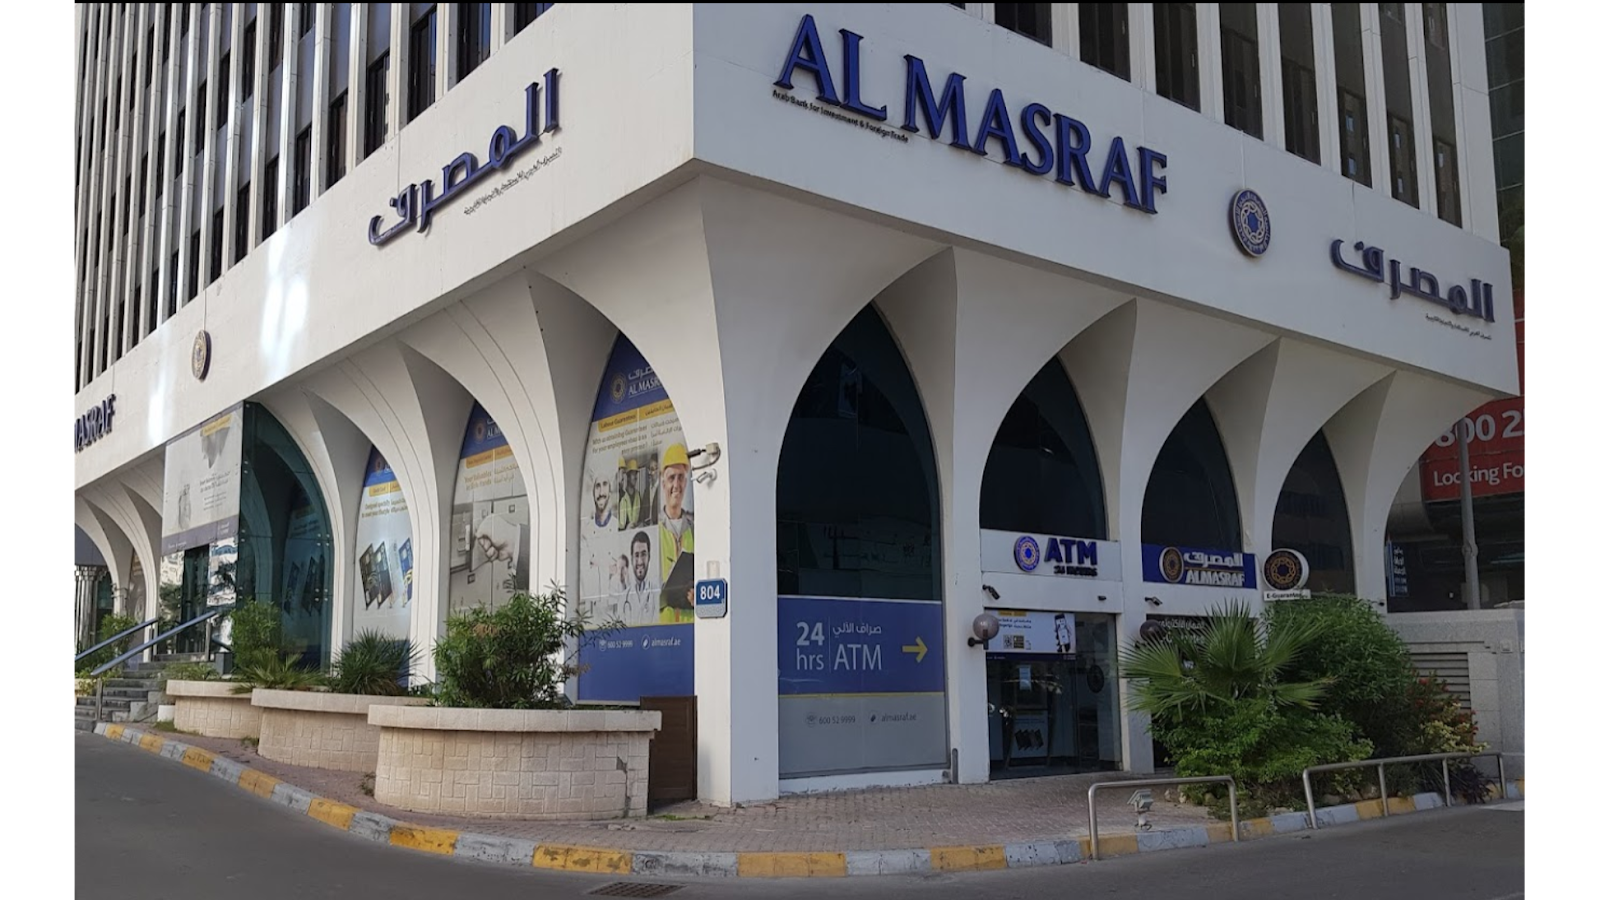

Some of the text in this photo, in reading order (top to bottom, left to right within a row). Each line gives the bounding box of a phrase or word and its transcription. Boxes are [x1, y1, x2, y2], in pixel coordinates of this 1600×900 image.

[773, 14, 1167, 214] AL MASRAF
[368, 68, 559, 245] المصرف
[1330, 239, 1495, 322] المصرف
[1502, 410, 1526, 438] 2
[1503, 462, 1525, 479] Fo
[1044, 537, 1098, 565] ATM
[1183, 552, 1243, 567] المصرف
[700, 585, 721, 600] 804
[796, 621, 825, 646] 24
[856, 623, 881, 636] صراف
[796, 647, 824, 670] hrs
[833, 644, 882, 670] ATM
[819, 712, 917, 724] 600 52 9999 almasraf.ae
